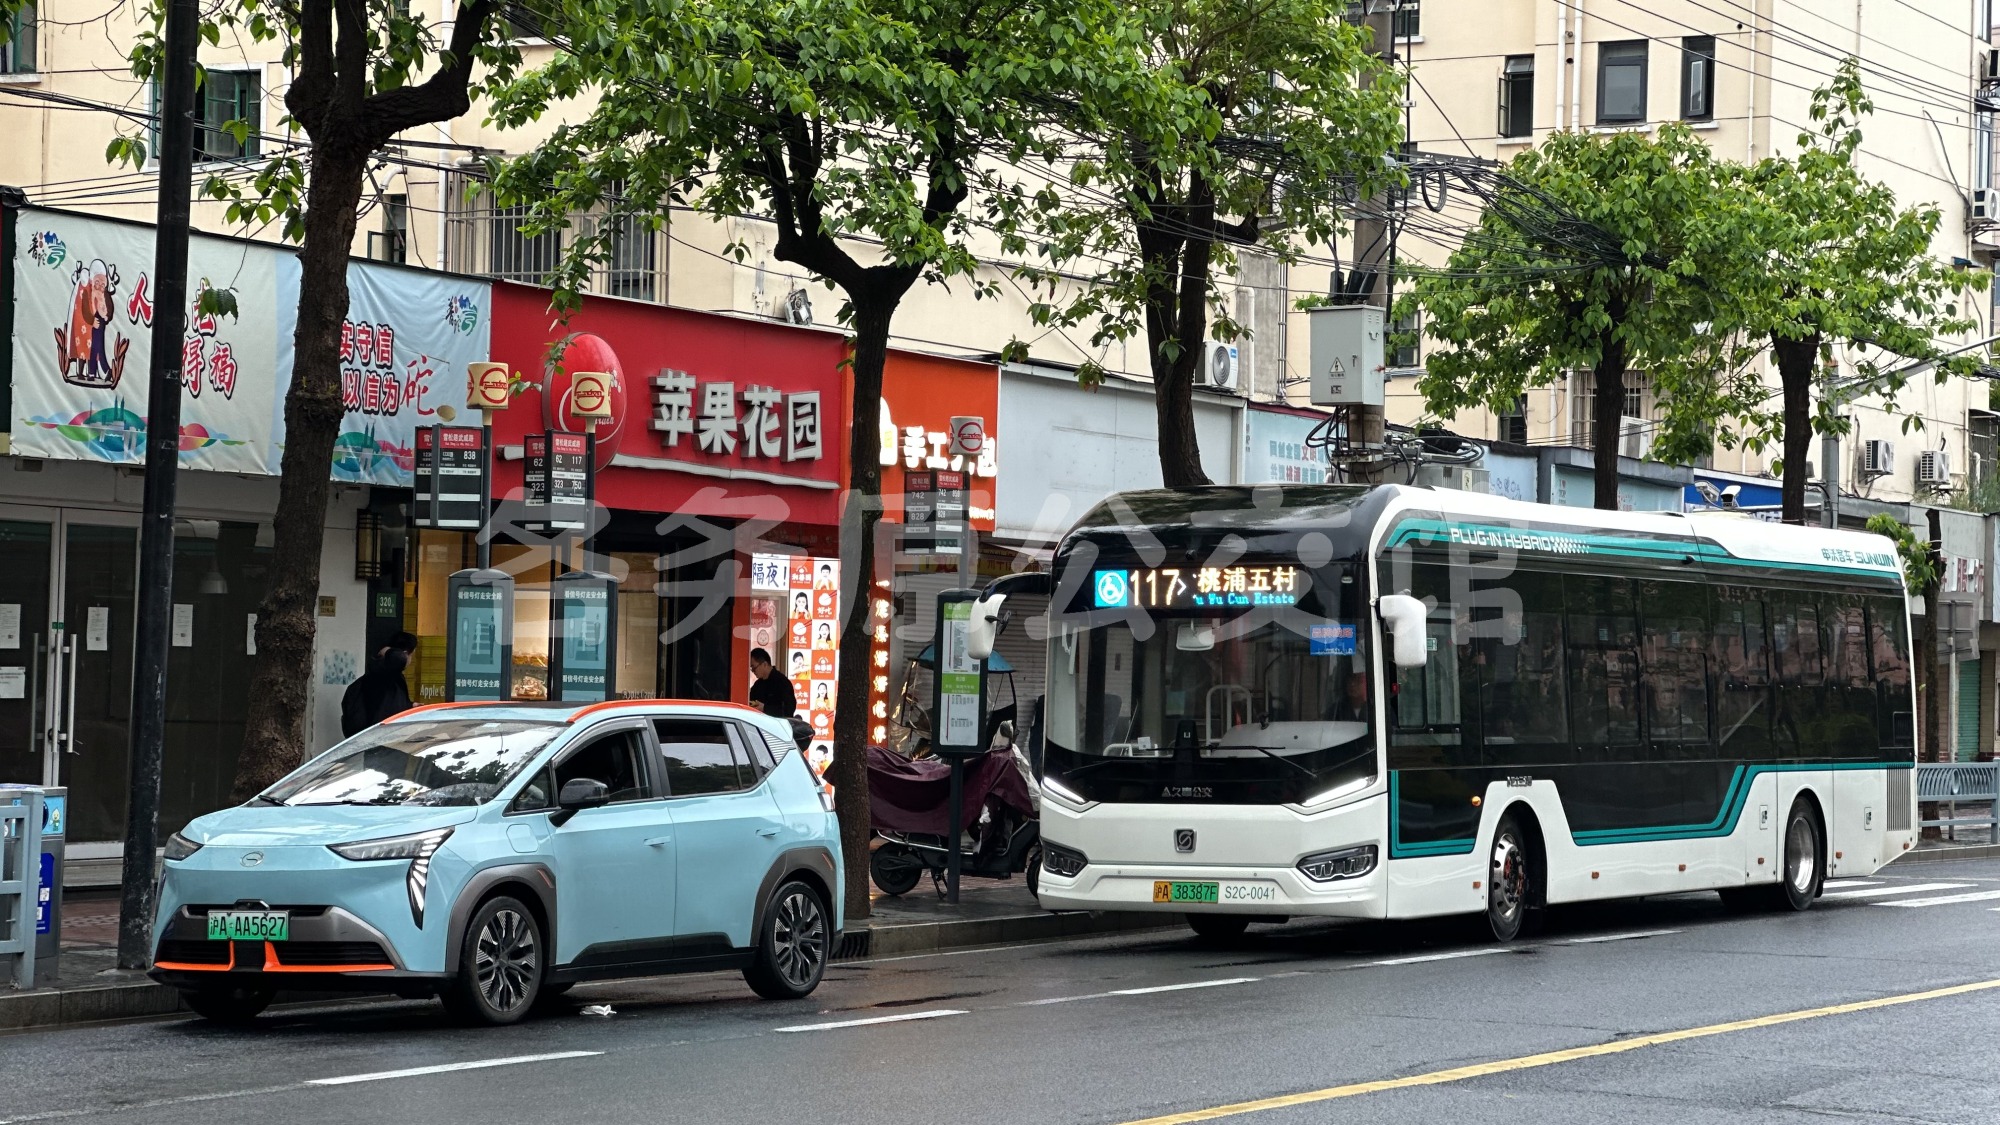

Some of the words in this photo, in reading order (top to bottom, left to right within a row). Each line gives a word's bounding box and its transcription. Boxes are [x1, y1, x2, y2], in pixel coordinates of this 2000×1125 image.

[649, 368, 822, 463] 苹果花园
[464, 451, 475, 460] 838
[556, 455, 562, 463] 62
[572, 456, 582, 465] 117
[534, 458, 543, 466] 62
[531, 483, 544, 491] 323
[554, 480, 563, 488] 323
[572, 481, 581, 489] 750
[1504, 533, 1551, 551] HYBRID
[1854, 551, 1896, 567] SUNWIN
[1130, 569, 1180, 606] 117
[1197, 566, 1297, 593] 桃浦五村
[457, 591, 503, 600] 看信号灯走安全路
[564, 590, 607, 600] 看信号灯走安全路
[1208, 593, 1223, 605] Wu
[1228, 593, 1249, 605] Cun
[1254, 592, 1295, 604] Estate
[380, 597, 391, 607] 320
[817, 607, 832, 615] 好吃
[792, 636, 807, 644] 卫生
[456, 679, 500, 688] 看信号灯走安全路
[562, 675, 605, 684] 看信号灯走安全路
[420, 684, 439, 699] Apple
[1224, 886, 1277, 901] S2C-0041
